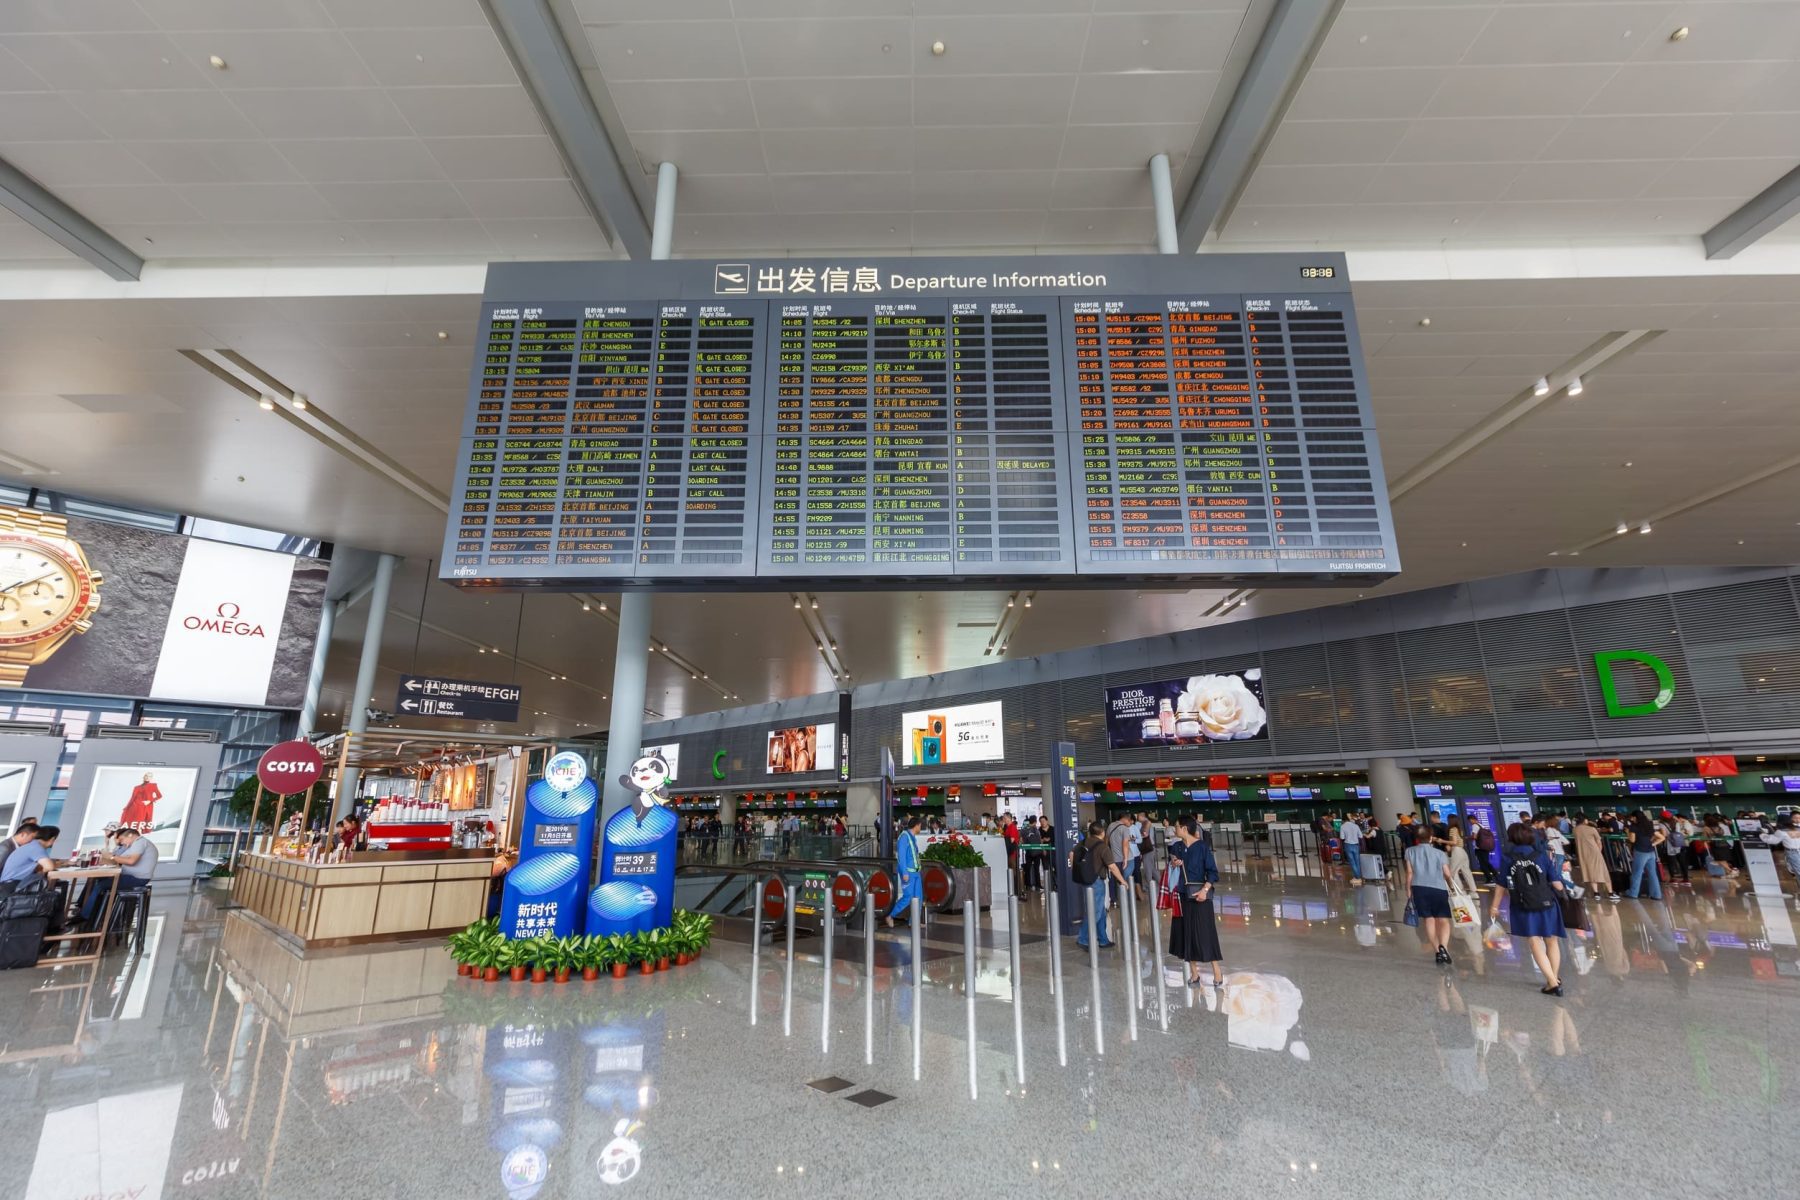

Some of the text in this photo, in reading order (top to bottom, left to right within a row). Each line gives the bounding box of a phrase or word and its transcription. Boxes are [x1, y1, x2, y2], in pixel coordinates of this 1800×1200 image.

[757, 267, 882, 293] 出发信息
[891, 273, 1106, 292] Departure Information
[454, 566, 477, 576] FUJITSU
[184, 617, 264, 637] OMEGA
[1594, 650, 1675, 718] D
[484, 687, 520, 701] EFGH
[1122, 690, 1144, 699] DIOR
[1112, 696, 1155, 707] PRESTIGE
[958, 732, 970, 741] 5G
[267, 761, 315, 773] COSTA
[712, 750, 727, 779] C
[633, 856, 643, 864] 39
[518, 902, 557, 917] 新时代
[516, 917, 556, 928] 共享未来
[515, 929, 536, 938] NEW
